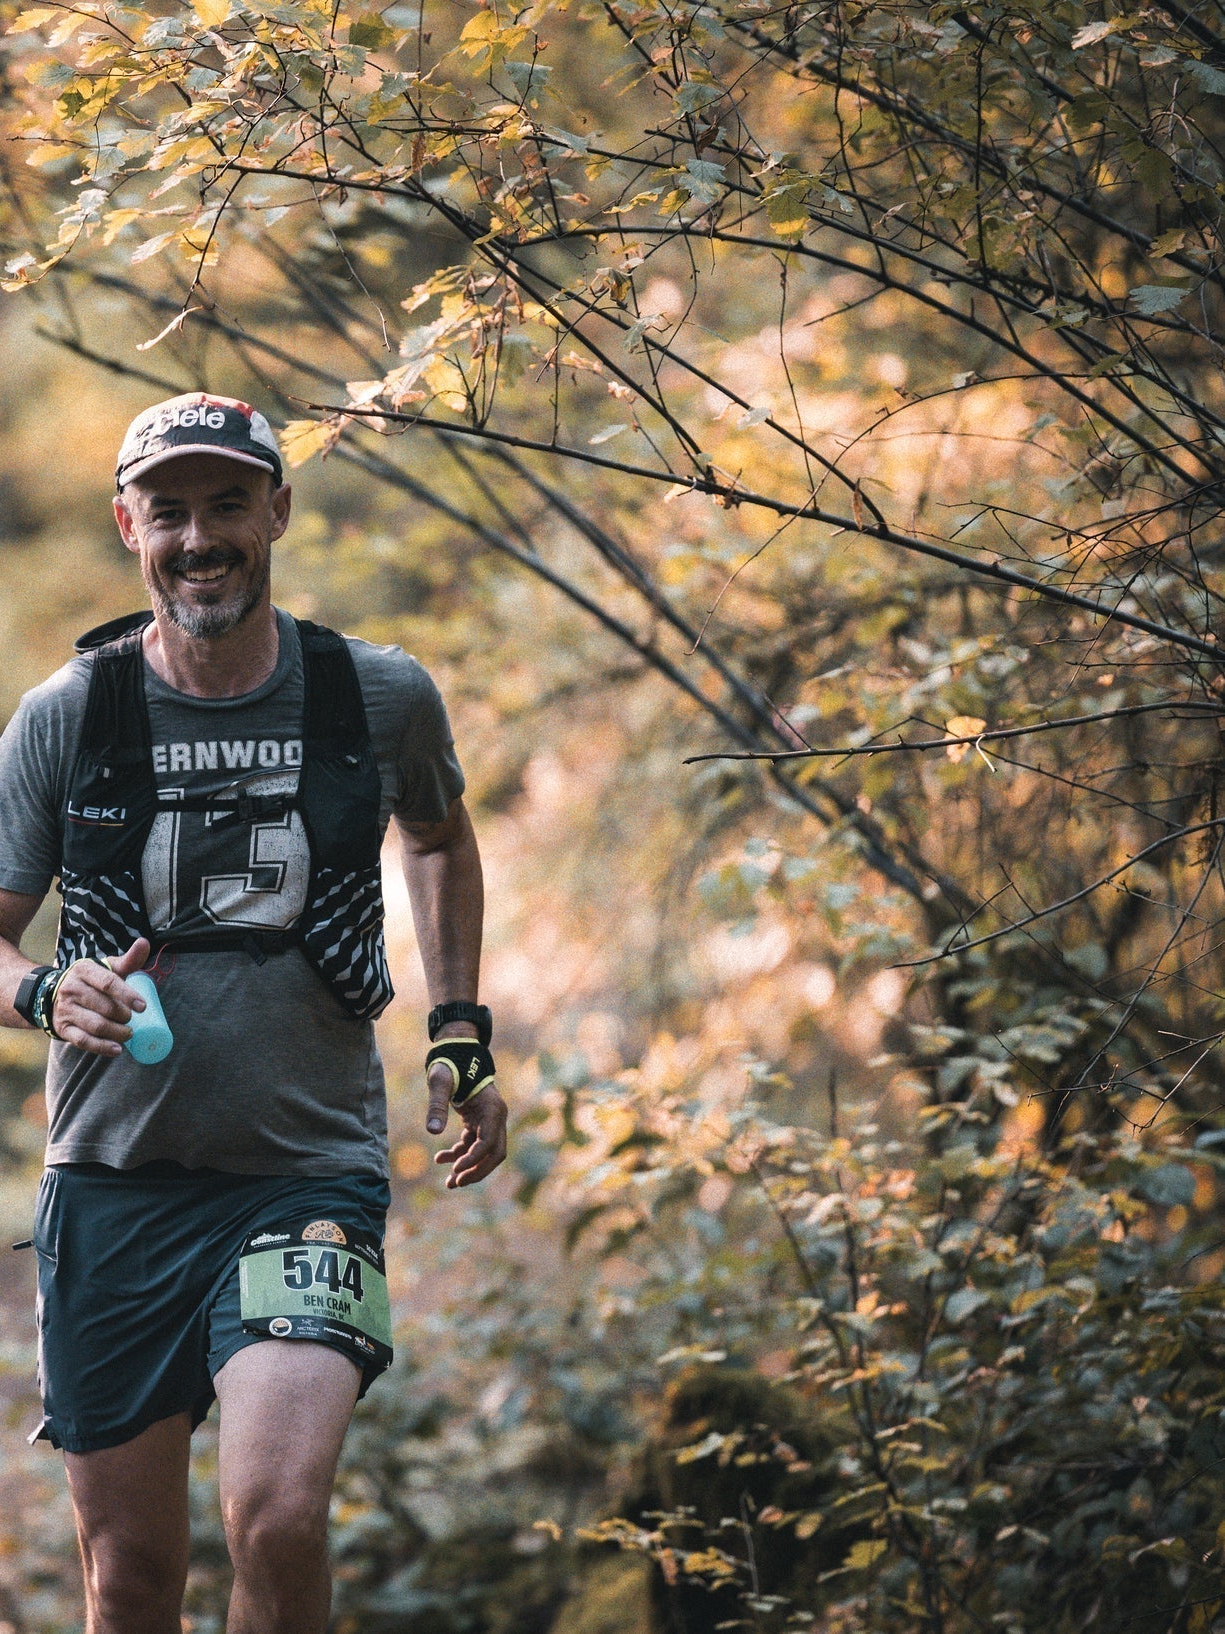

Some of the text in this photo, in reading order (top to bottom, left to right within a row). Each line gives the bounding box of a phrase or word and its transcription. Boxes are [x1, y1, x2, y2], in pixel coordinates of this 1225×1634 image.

[68, 800, 125, 820] LEKI
[466, 1056, 481, 1080] LEKI
[305, 1221, 344, 1242] FINLAYSON
[282, 1248, 364, 1304] 544
[303, 1294, 351, 1315] BEN CRAM
